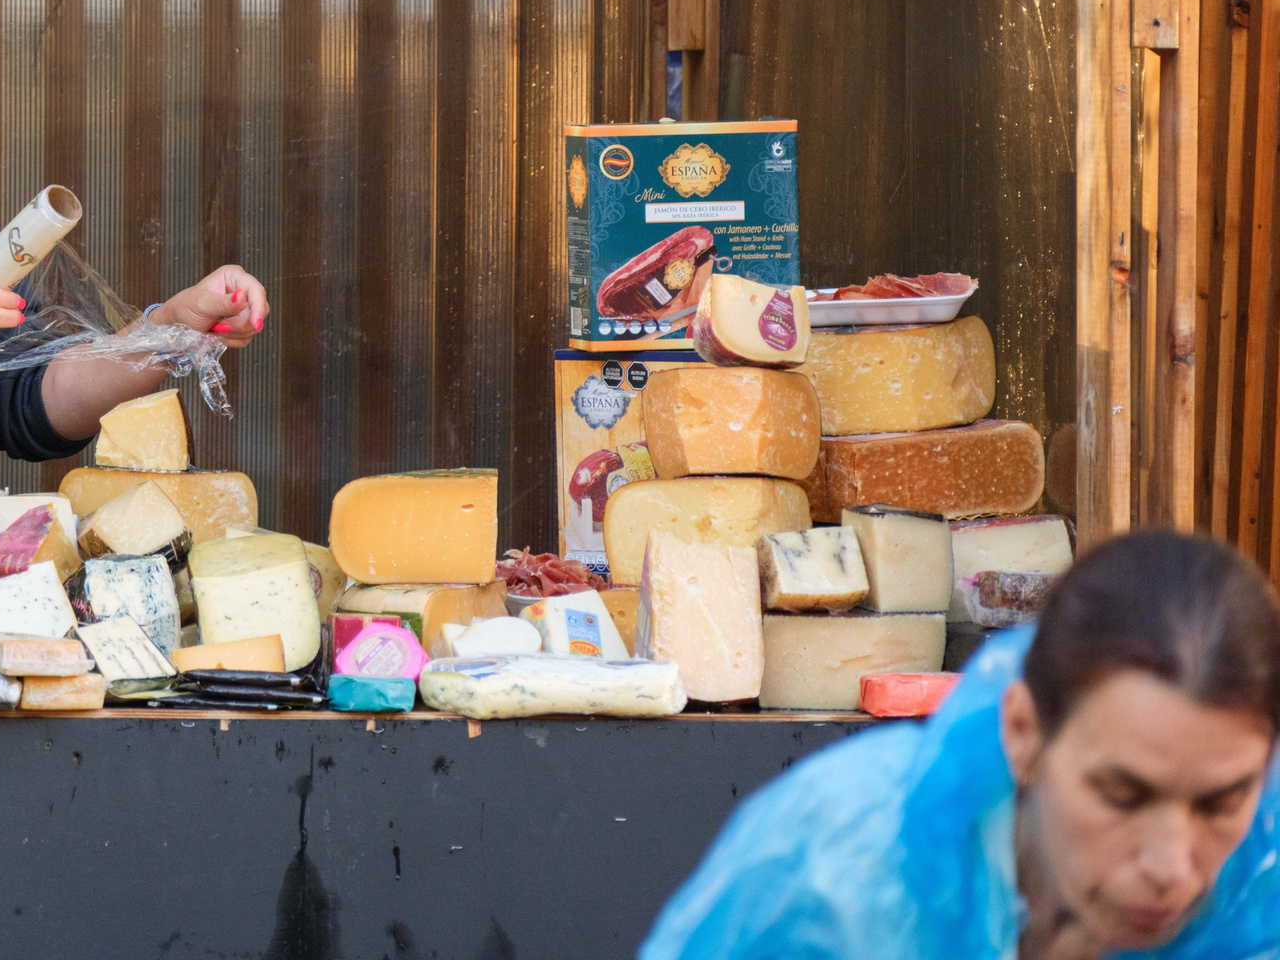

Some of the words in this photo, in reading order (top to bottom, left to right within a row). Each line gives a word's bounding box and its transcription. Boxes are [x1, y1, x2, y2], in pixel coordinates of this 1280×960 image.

[671, 163, 718, 177] ESPAÑA
[634, 187, 666, 203] Mini
[654, 206, 678, 214] JAMÓN
[713, 226, 727, 235] con
[727, 224, 762, 234] Jamonero
[771, 222, 799, 233] Cuchillo
[8, 226, 35, 267] CAST
[743, 243, 757, 251] Griffe
[762, 243, 782, 251] Couteau
[581, 395, 620, 408] ESPAÑA
